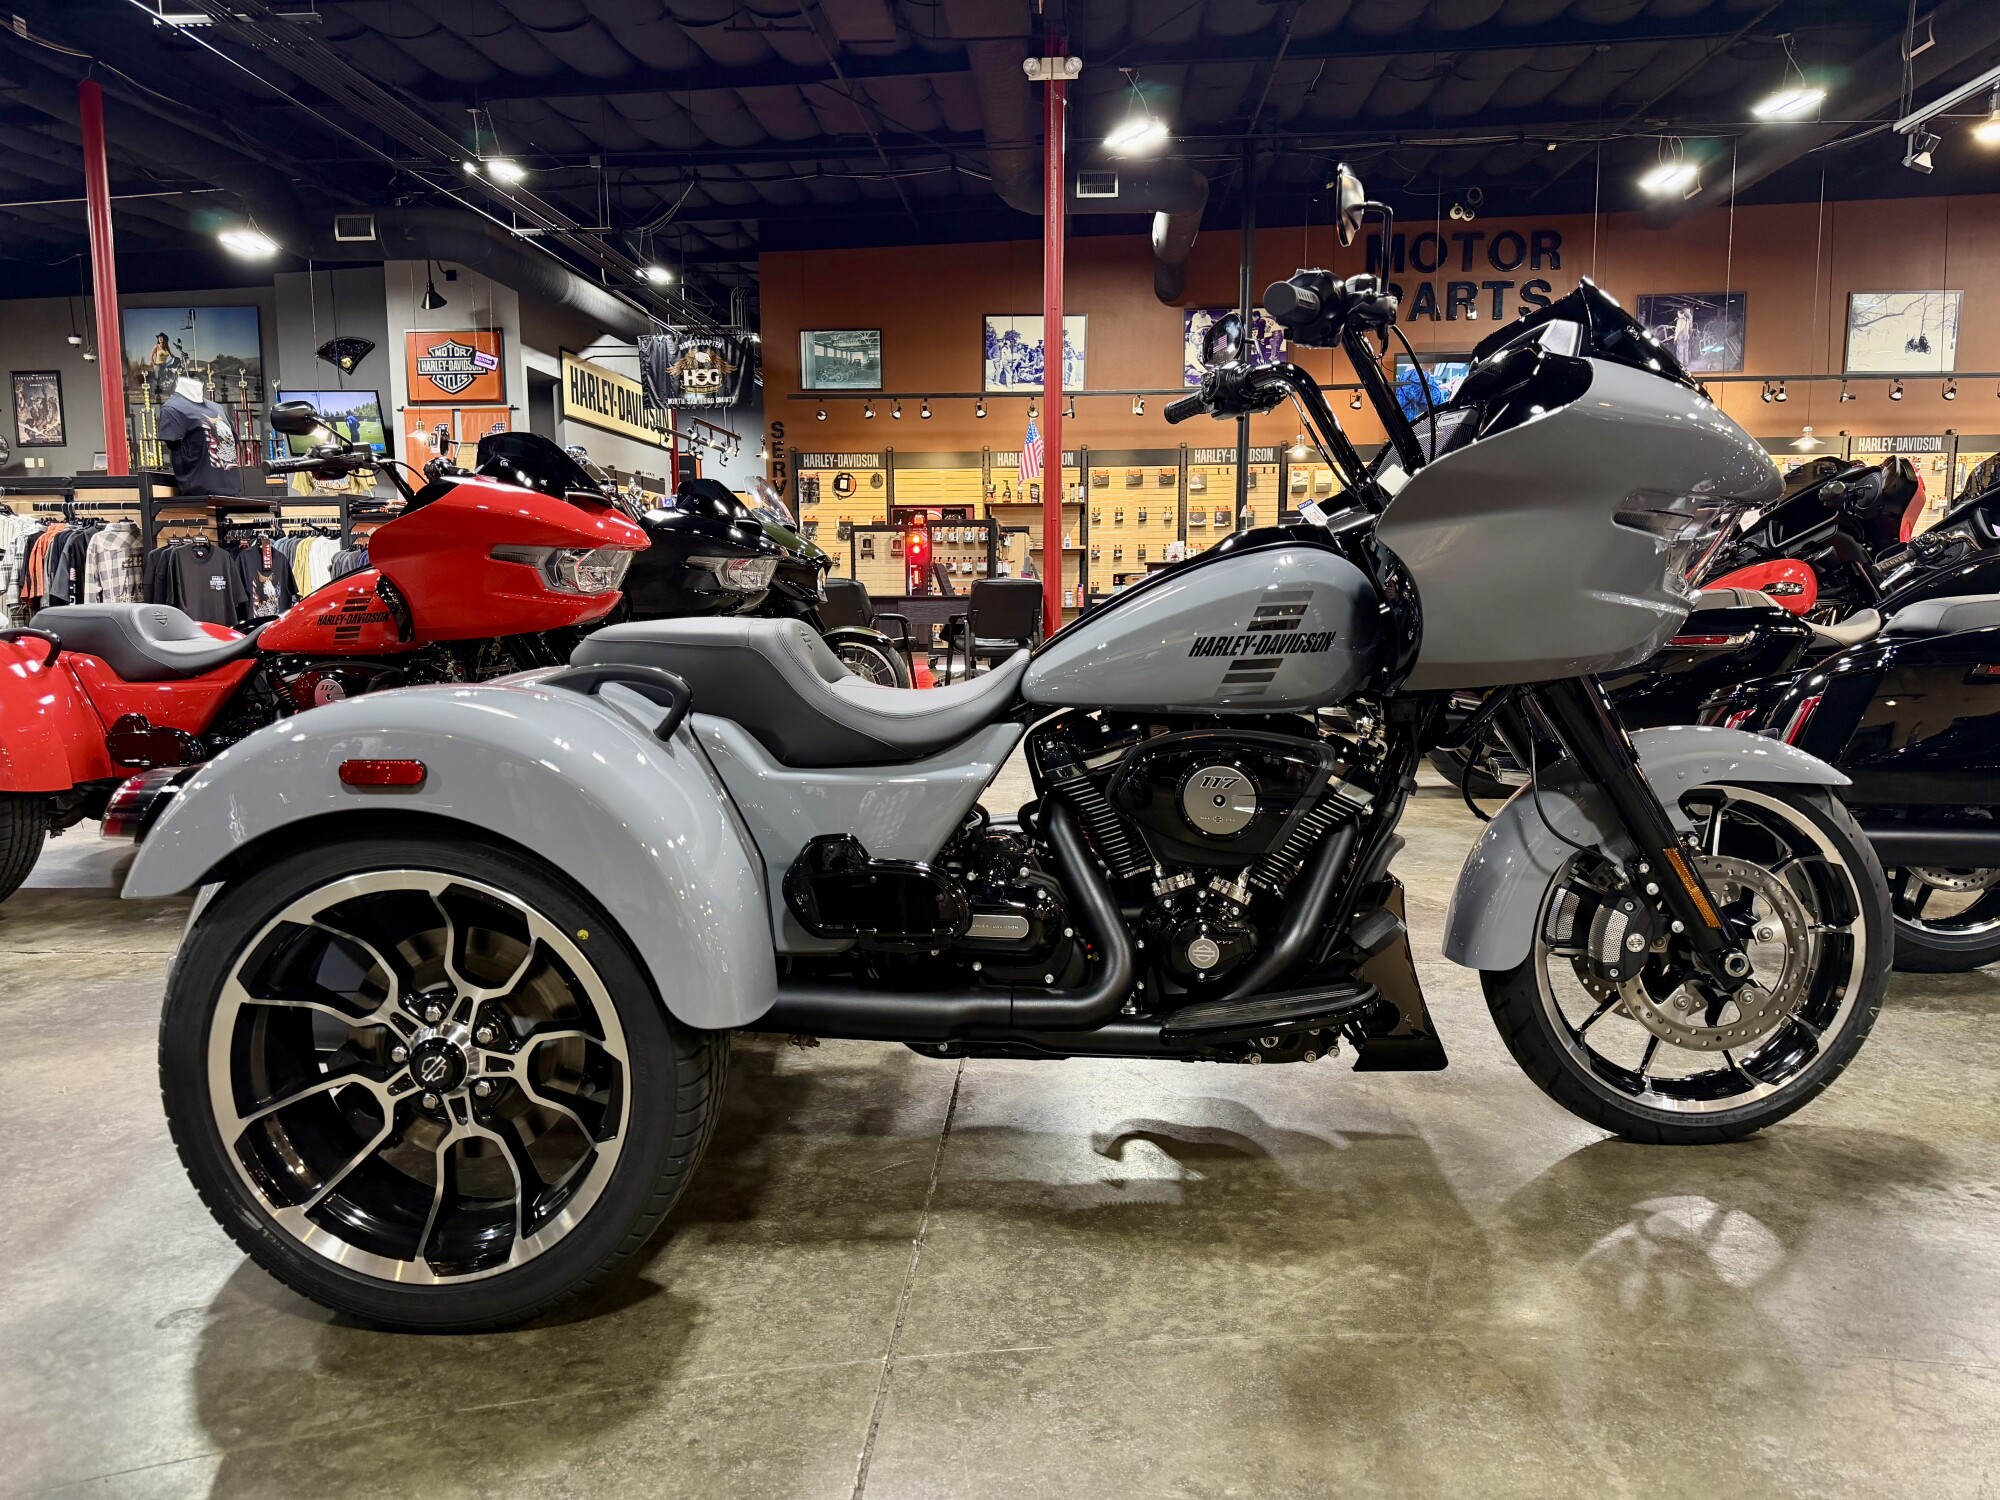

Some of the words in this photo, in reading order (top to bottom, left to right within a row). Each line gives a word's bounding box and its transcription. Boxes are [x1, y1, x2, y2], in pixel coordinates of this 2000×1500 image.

[1366, 230, 1562, 273] MOTOR
[1388, 279, 1552, 321] ARTS
[434, 344, 467, 357] MOTOR
[436, 374, 468, 389] CYCLES
[683, 369, 719, 386] HOG
[570, 365, 670, 437] HARLEY-DAVIDSON
[1858, 437, 1942, 451] HARLEY-DAVIDSON
[803, 454, 879, 467] HARLEY-DAVIDSON
[998, 453, 1074, 466] HARLEAON
[1194, 448, 1274, 463] HARLEY-DDSON
[317, 612, 390, 626] HARLEY-DAVIDSON
[1188, 632, 1337, 657] HARLEY-DAVIDSON
[1200, 776, 1242, 789] 117
